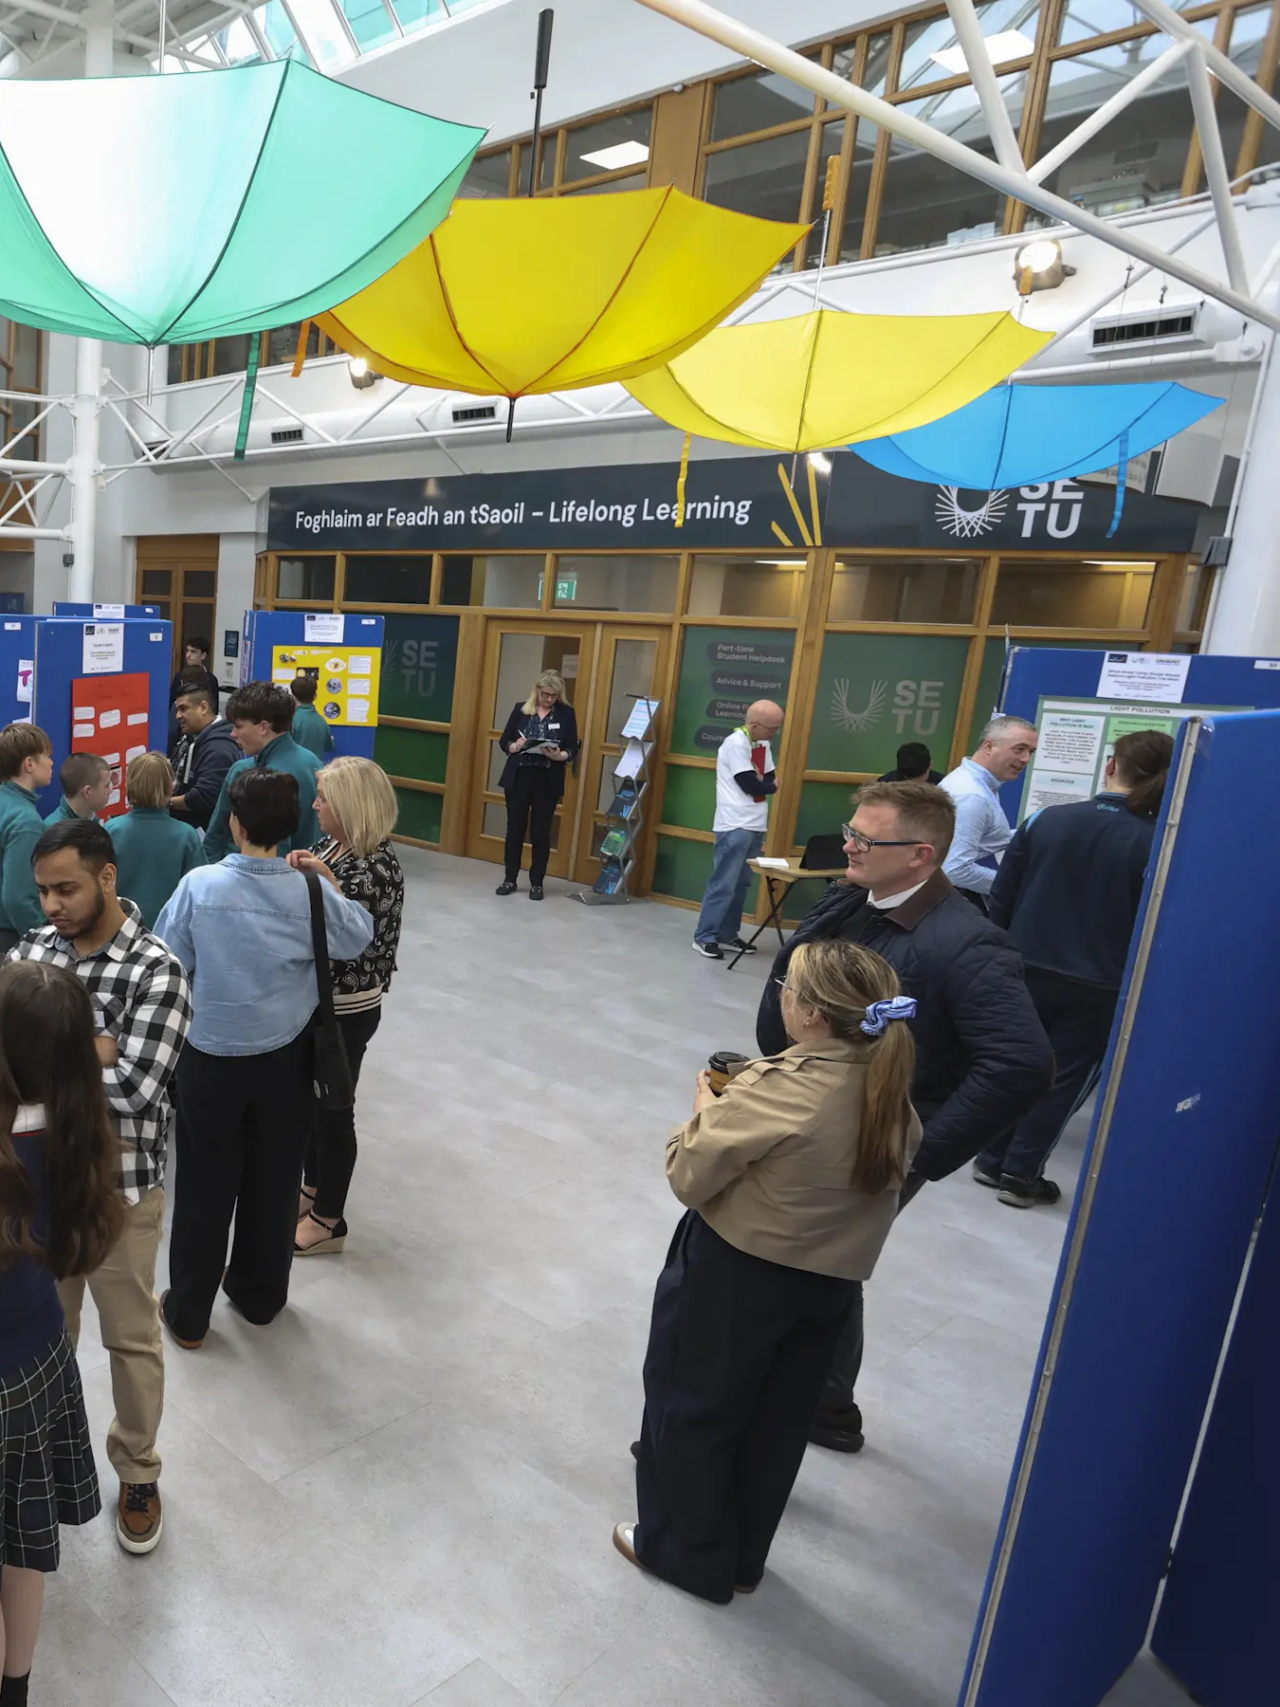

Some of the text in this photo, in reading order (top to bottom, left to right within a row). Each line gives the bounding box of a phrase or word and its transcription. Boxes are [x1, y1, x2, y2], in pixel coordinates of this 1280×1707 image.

[295, 509, 363, 533] Foghlaim
[366, 512, 383, 527] ar
[386, 506, 439, 527] Feadh
[443, 510, 465, 525] an
[470, 502, 524, 525] tSaoil
[549, 499, 637, 527] Lifelong
[1017, 503, 1082, 539] TU
[401, 639, 439, 668] SE
[716, 652, 786, 664] Student Helpdesk
[716, 677, 742, 686] Advice
[750, 680, 782, 690] Support
[893, 680, 944, 707] SE
[891, 708, 940, 736] TU
